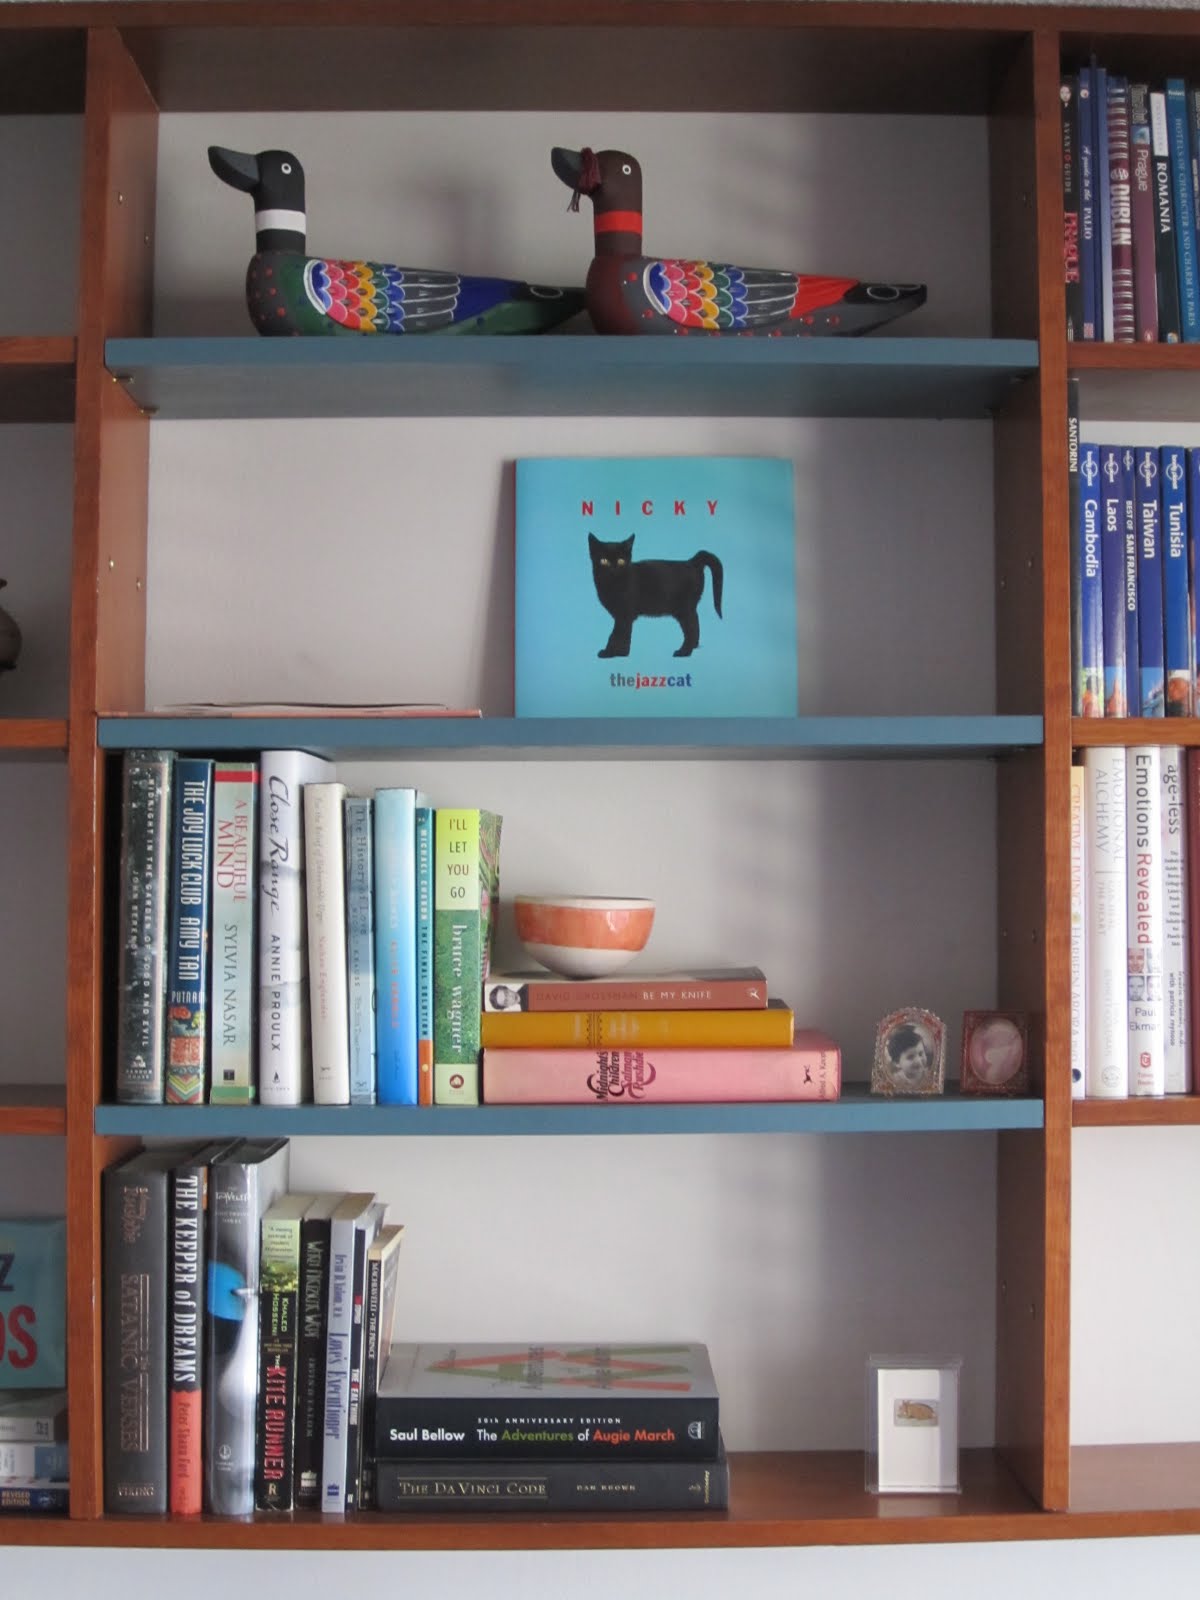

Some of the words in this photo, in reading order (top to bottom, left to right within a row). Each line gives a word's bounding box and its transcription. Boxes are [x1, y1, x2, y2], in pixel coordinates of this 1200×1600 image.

[1175, 118, 1186, 157] HOTELS
[1134, 149, 1149, 191] Prague
[1110, 184, 1131, 246] DUBLIN
[1156, 162, 1171, 233] ROMANIA
[1083, 207, 1092, 240] PALIO
[1182, 231, 1191, 249] AND
[1063, 211, 1079, 284] PRAGUE
[1184, 252, 1193, 286] CHARM
[1186, 288, 1194, 299] IN
[1187, 301, 1196, 327] PARIS
[1068, 417, 1078, 473] SANTORINI
[582, 500, 718, 516] NICKY
[1106, 498, 1119, 532] Laos
[1126, 520, 1134, 530] OF
[1084, 499, 1098, 577] Cambodia
[1126, 534, 1135, 554] SAN
[1142, 500, 1158, 559] Taiwan
[1169, 502, 1184, 558] Tunisia
[1126, 556, 1136, 611] FRANCISCO
[610, 672, 692, 689] thejazzcat
[146, 778, 155, 835] MIDNIGHT
[182, 780, 205, 804] THE
[234, 800, 248, 810] A
[268, 775, 291, 835] Close
[1135, 754, 1153, 848] Emotions
[1163, 764, 1183, 835] age-less
[182, 808, 204, 833] JOY
[355, 808, 365, 834] The
[449, 818, 468, 831] I'LL
[1095, 767, 1110, 854] ALCHEMY
[1111, 758, 1126, 863] EMOTIONAL
[146, 839, 154, 852] IN
[181, 837, 203, 870] LUCK
[216, 819, 235, 889] MIND
[233, 815, 249, 904] BEAUTIFUL
[353, 836, 367, 883] History
[420, 829, 428, 875] MICHAEL
[449, 841, 468, 854] LET
[131, 870, 139, 900] JOHN
[145, 857, 154, 878] THE
[262, 837, 289, 916] Range
[447, 863, 470, 876] YOU
[144, 883, 153, 930] GARDEN
[180, 873, 202, 905] CLUB
[450, 886, 467, 899] GO
[1137, 853, 1153, 945] Revealed
[179, 917, 201, 949] AMY
[358, 904, 368, 935] Love
[143, 936, 152, 949] OF
[223, 924, 238, 982] SYLVIA
[270, 934, 281, 982] ANNIE
[451, 923, 467, 977] bruce
[143, 956, 151, 987] GOOD
[178, 955, 200, 981] TAN
[142, 992, 150, 1015] AND
[421, 985, 429, 1037] SOLUTION
[642, 991, 655, 1001] BE
[660, 990, 677, 1000] MY
[681, 990, 713, 1000] KNIFE
[1167, 990, 1176, 1017] patricia
[141, 1020, 150, 1047] EVIL
[222, 989, 237, 1046] NASAR
[270, 991, 281, 1052] PROULX
[448, 984, 463, 1054] wagner
[175, 1175, 198, 1211] THE
[174, 1217, 197, 1284] KEEPER
[174, 1290, 197, 1307] of
[369, 1262, 379, 1312] MACHIAVELLI
[120, 1273, 139, 1369] SATANIC
[271, 1292, 280, 1337] HOSSEINI
[281, 1297, 289, 1333] KHALED
[368, 1317, 377, 1333] THE
[173, 1313, 196, 1382] DREAMS
[328, 1331, 349, 1365] Love's
[368, 1333, 377, 1360] PRINCE
[265, 1366, 286, 1405] KITE
[351, 1368, 360, 1383] THE
[120, 1377, 139, 1452] VERSES
[324, 1370, 348, 1441] Executioner
[263, 1409, 285, 1480] RUNNER
[389, 1428, 418, 1442] Saul
[421, 1428, 466, 1442] Bellow
[476, 1428, 498, 1442] The
[501, 1428, 574, 1442] Adventures
[577, 1427, 590, 1442] of
[592, 1428, 631, 1444] Augie
[634, 1428, 676, 1442] March
[506, 1482, 546, 1495] CODE
[601, 1484, 636, 1492] BROWN
